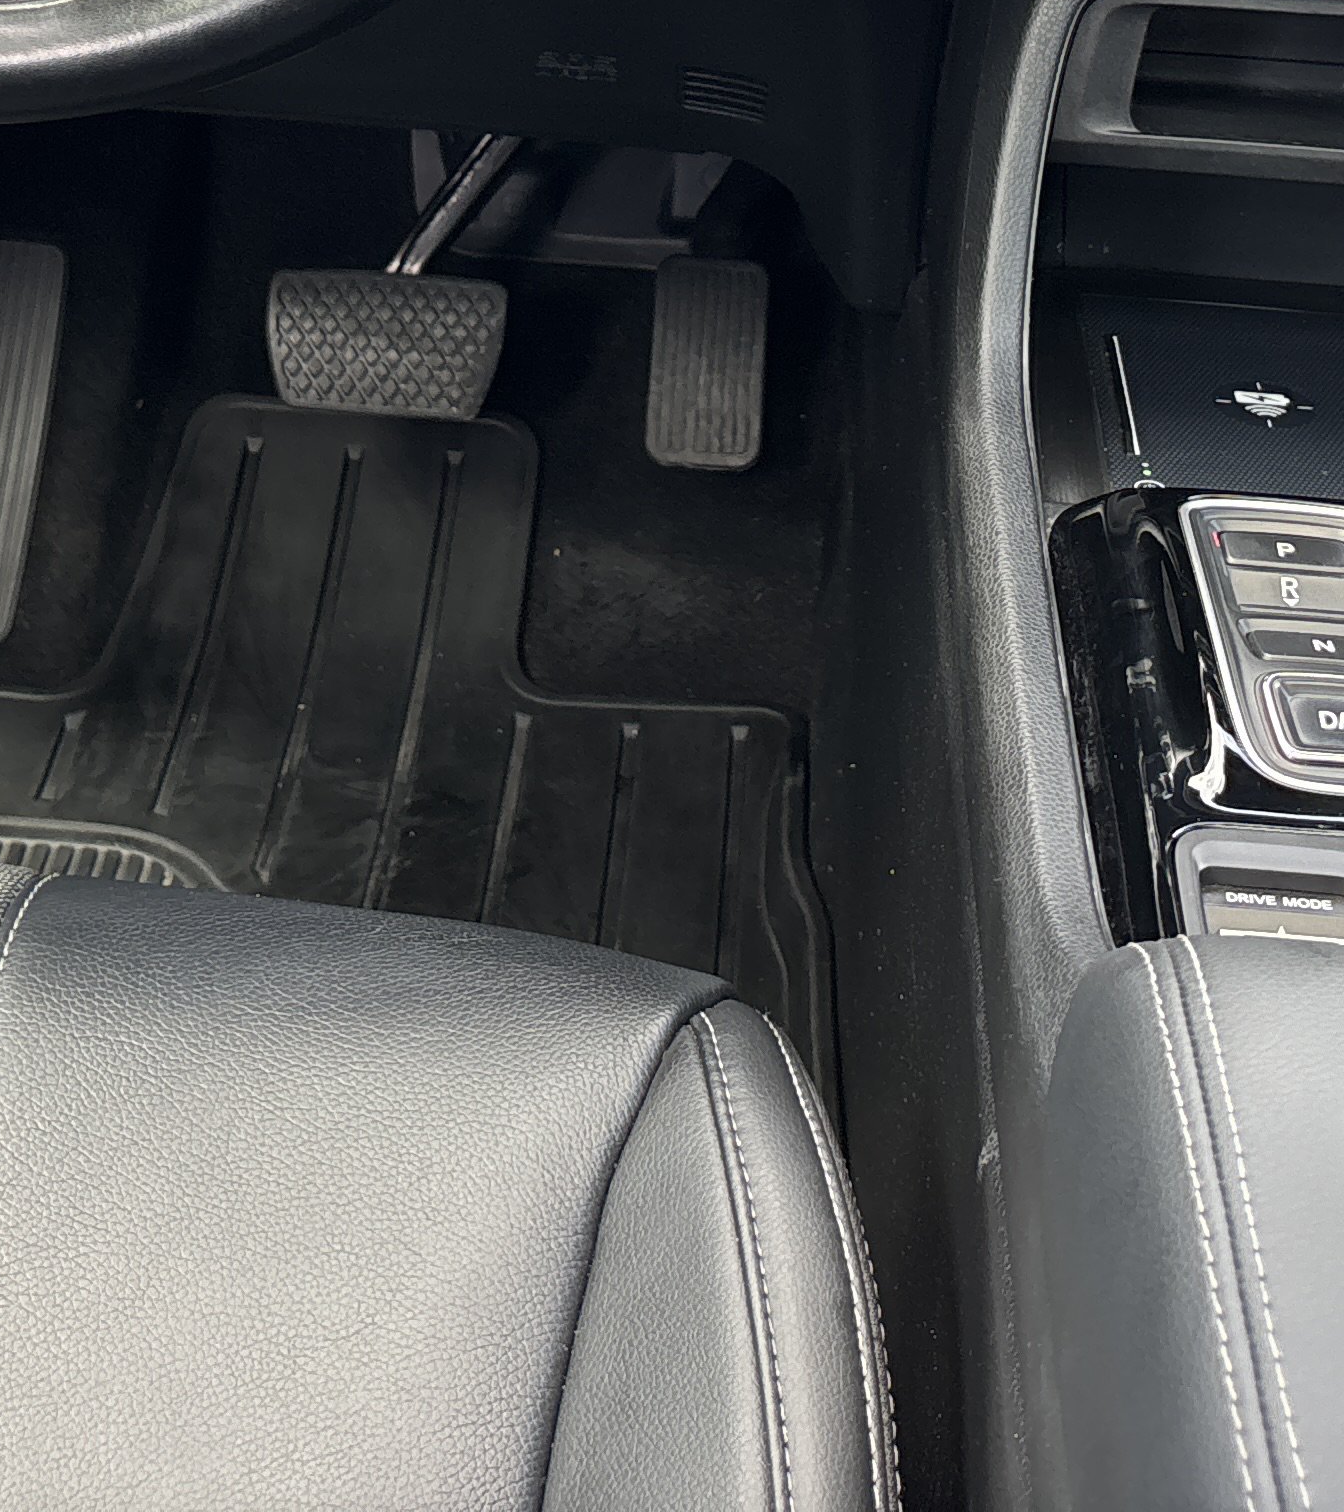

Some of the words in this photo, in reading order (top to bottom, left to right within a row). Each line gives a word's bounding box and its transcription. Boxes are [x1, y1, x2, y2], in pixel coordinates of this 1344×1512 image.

[1276, 542, 1295, 558] P
[1281, 576, 1298, 599] R
[1311, 639, 1335, 652] N
[1225, 890, 1276, 908] DRIVE
[1282, 895, 1333, 911] MODE
